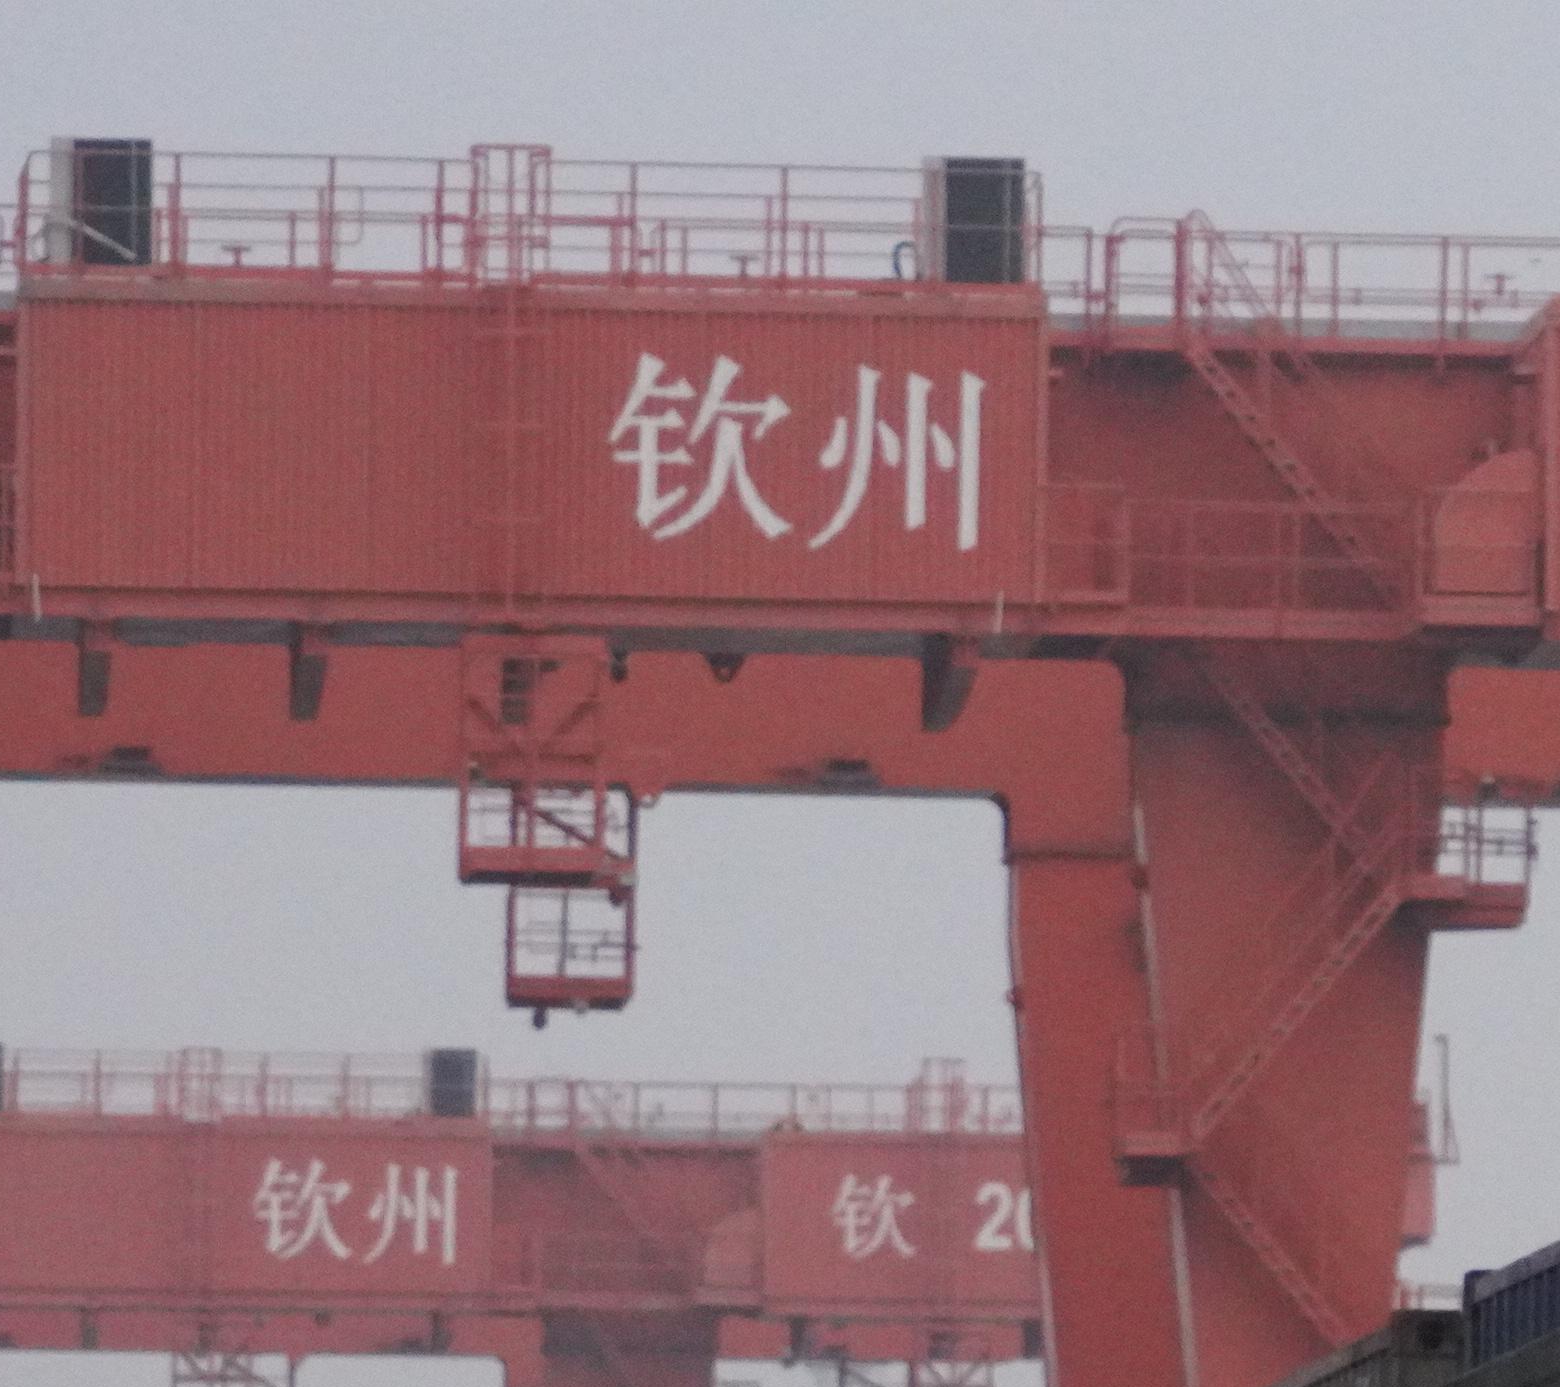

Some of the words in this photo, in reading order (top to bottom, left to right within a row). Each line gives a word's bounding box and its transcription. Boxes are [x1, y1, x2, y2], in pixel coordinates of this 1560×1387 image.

[608, 352, 986, 551] 钦州
[252, 1157, 458, 1265] 钦州
[832, 1174, 916, 1258] 钦
